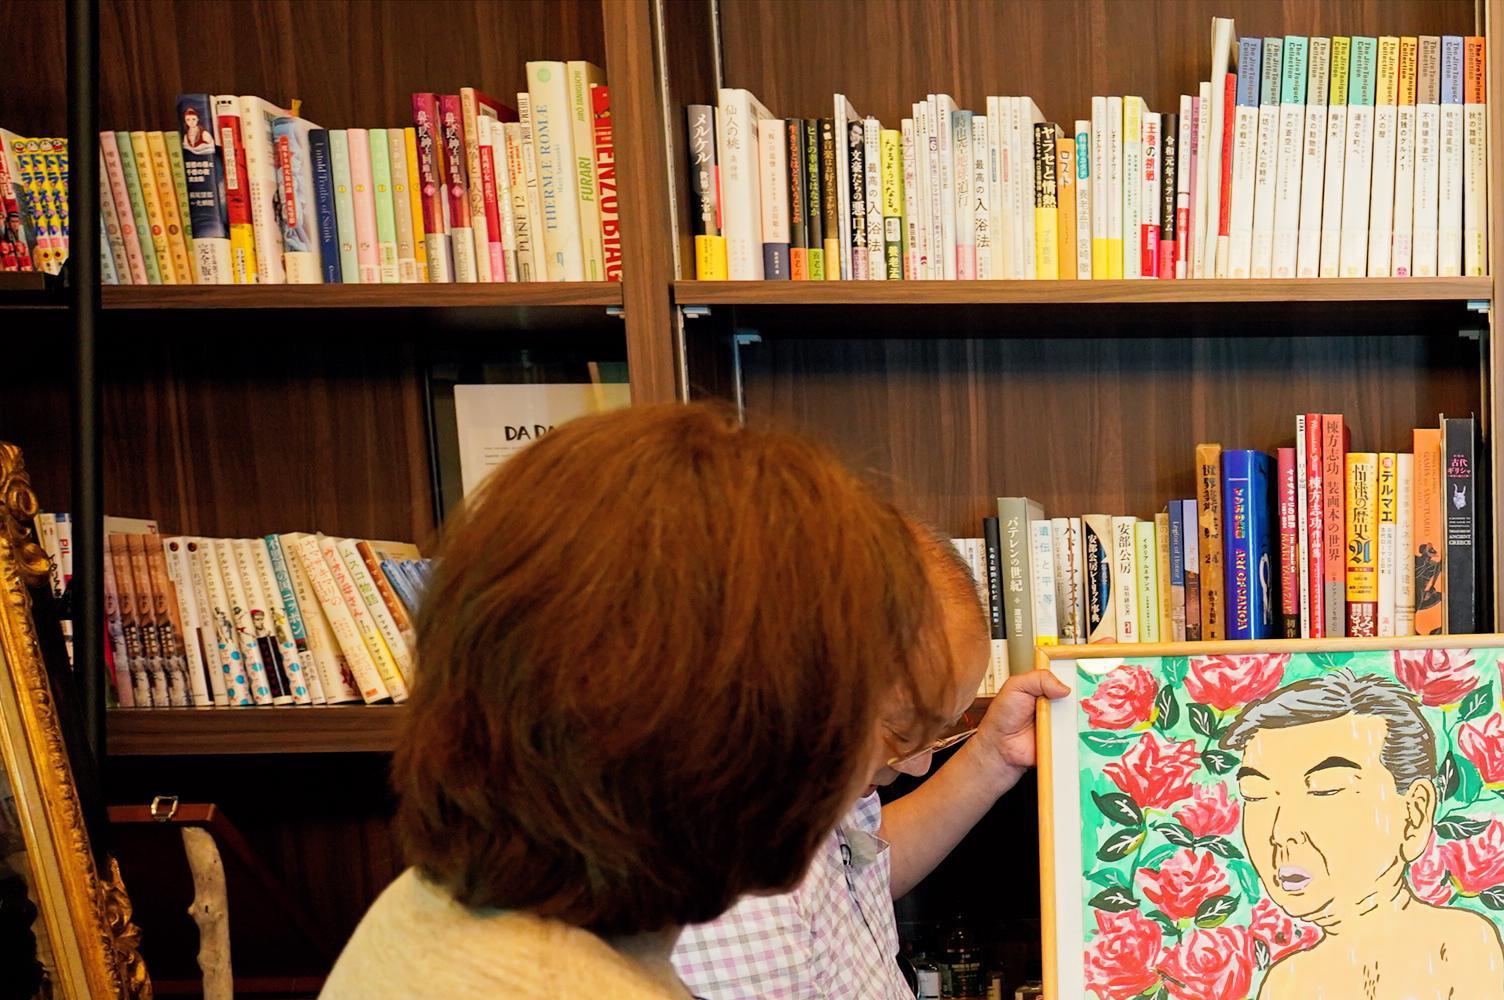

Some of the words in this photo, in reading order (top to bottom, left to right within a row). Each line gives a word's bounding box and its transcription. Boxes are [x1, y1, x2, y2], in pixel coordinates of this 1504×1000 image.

[693, 114, 711, 165] メルケル
[1145, 122, 1157, 181] 王者の挑戦
[315, 142, 325, 173] Untold
[322, 213, 333, 243] Saints
[578, 157, 594, 202] FURARI
[1060, 150, 1070, 188] ロスト
[1165, 135, 1176, 231] 令和元年のテロリズム
[851, 150, 867, 247] 文豪たちの悪口本
[868, 163, 882, 252] 最高の入浴法
[975, 160, 990, 248] 最高の入浴法
[505, 426, 531, 441] DA
[1326, 420, 1339, 476] 棟方志功
[1451, 459, 1468, 467] 古代
[1309, 477, 1322, 528] 棟方志功
[1327, 482, 1340, 561] 装画本の世界
[1353, 464, 1369, 540] 情報の歴史
[1381, 470, 1393, 522] テルマエ
[1008, 517, 1023, 592] バテレンの世紀
[1118, 523, 1131, 575] 安部公房
